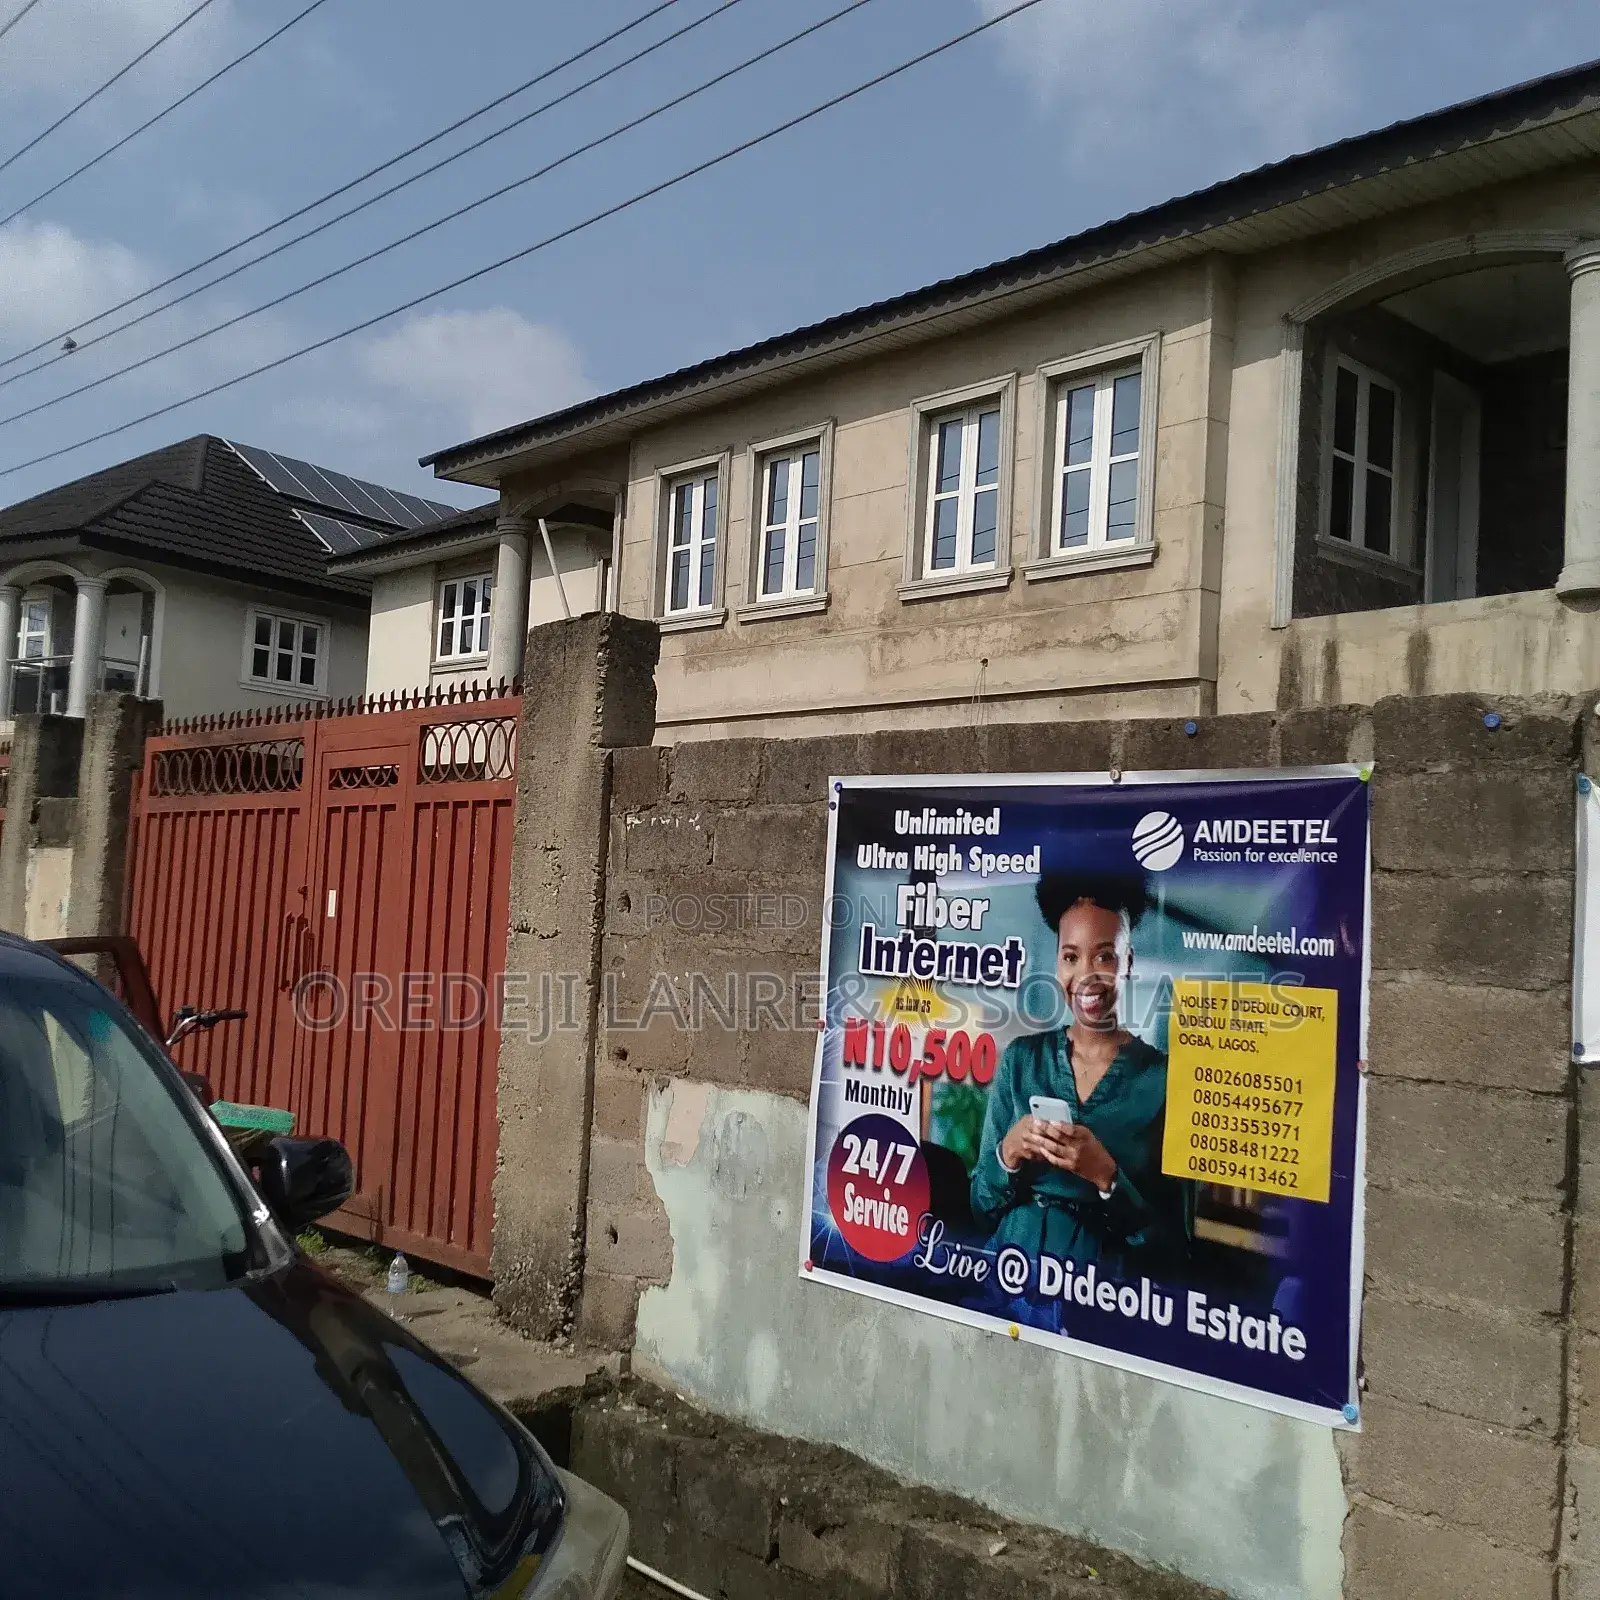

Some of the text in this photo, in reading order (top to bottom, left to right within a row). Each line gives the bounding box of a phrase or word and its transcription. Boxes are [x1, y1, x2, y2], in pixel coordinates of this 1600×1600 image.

[894, 807, 1001, 836] Unlimited
[1192, 819, 1338, 844] AMDEETEL
[857, 842, 1041, 878] Ultra High Speed
[1193, 847, 1338, 863] Passion for excellence
[896, 881, 989, 931] Fiber
[858, 922, 1025, 989] Internet
[1181, 925, 1335, 957] www.amdeetel.com
[895, 996, 904, 1011] as
[921, 999, 931, 1014] as
[1180, 995, 1326, 1022] HOUSE 7 DIDEOLU COURT,
[1178, 1014, 1269, 1037] DIDEOLU ESTATE,
[1178, 1033, 1260, 1054] OGBA, LAGOS.
[1194, 1066, 1303, 1095] 08026085501
[844, 1079, 913, 1116] Monthly
[1193, 1089, 1304, 1118] 08054495677
[1191, 1111, 1301, 1141] 08033553971
[841, 1134, 917, 1186] 24/7
[1190, 1133, 1300, 1165] 08058481222
[1188, 1155, 1299, 1189] 08059413462
[842, 1182, 909, 1237] Service
[913, 1212, 1308, 1361] Live @ Dideolu Estate
